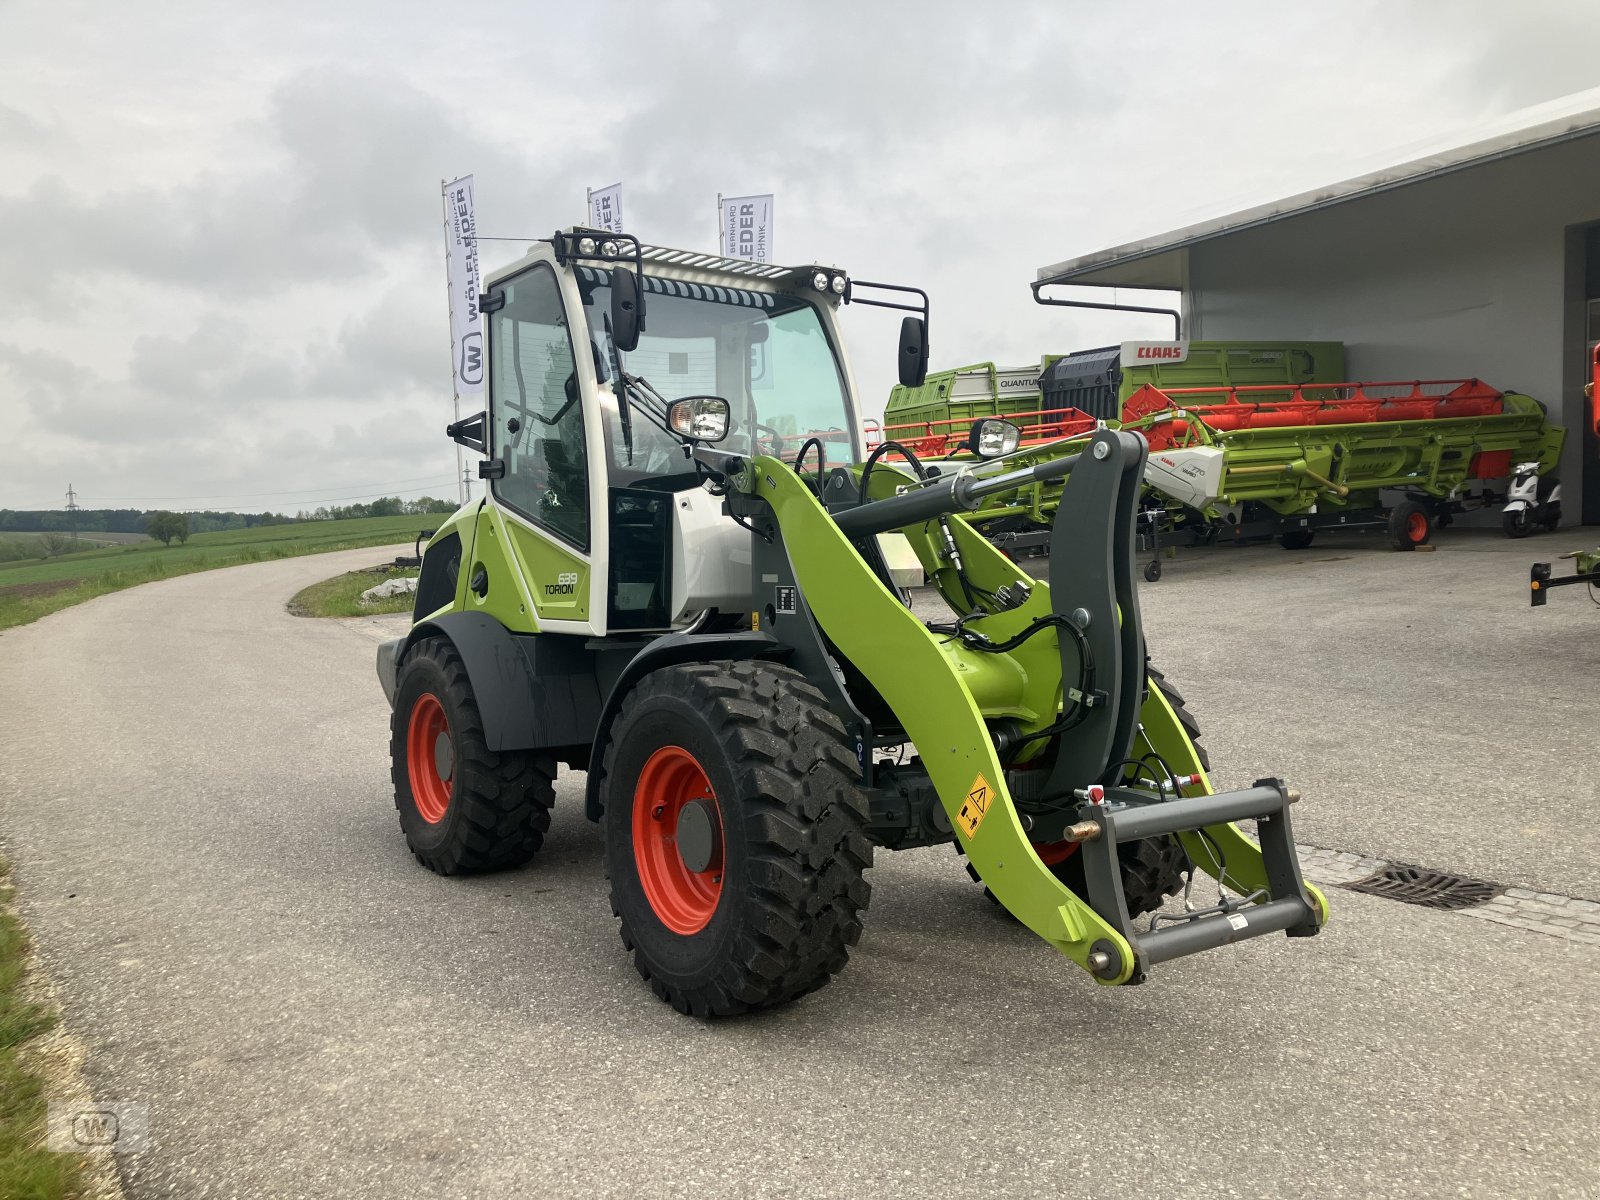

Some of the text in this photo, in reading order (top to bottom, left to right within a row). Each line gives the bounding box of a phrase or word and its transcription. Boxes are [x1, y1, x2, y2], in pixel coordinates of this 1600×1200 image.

[1137, 346, 1181, 359] CLAAS
[558, 572, 578, 585] 639
[544, 584, 574, 595] TORION
